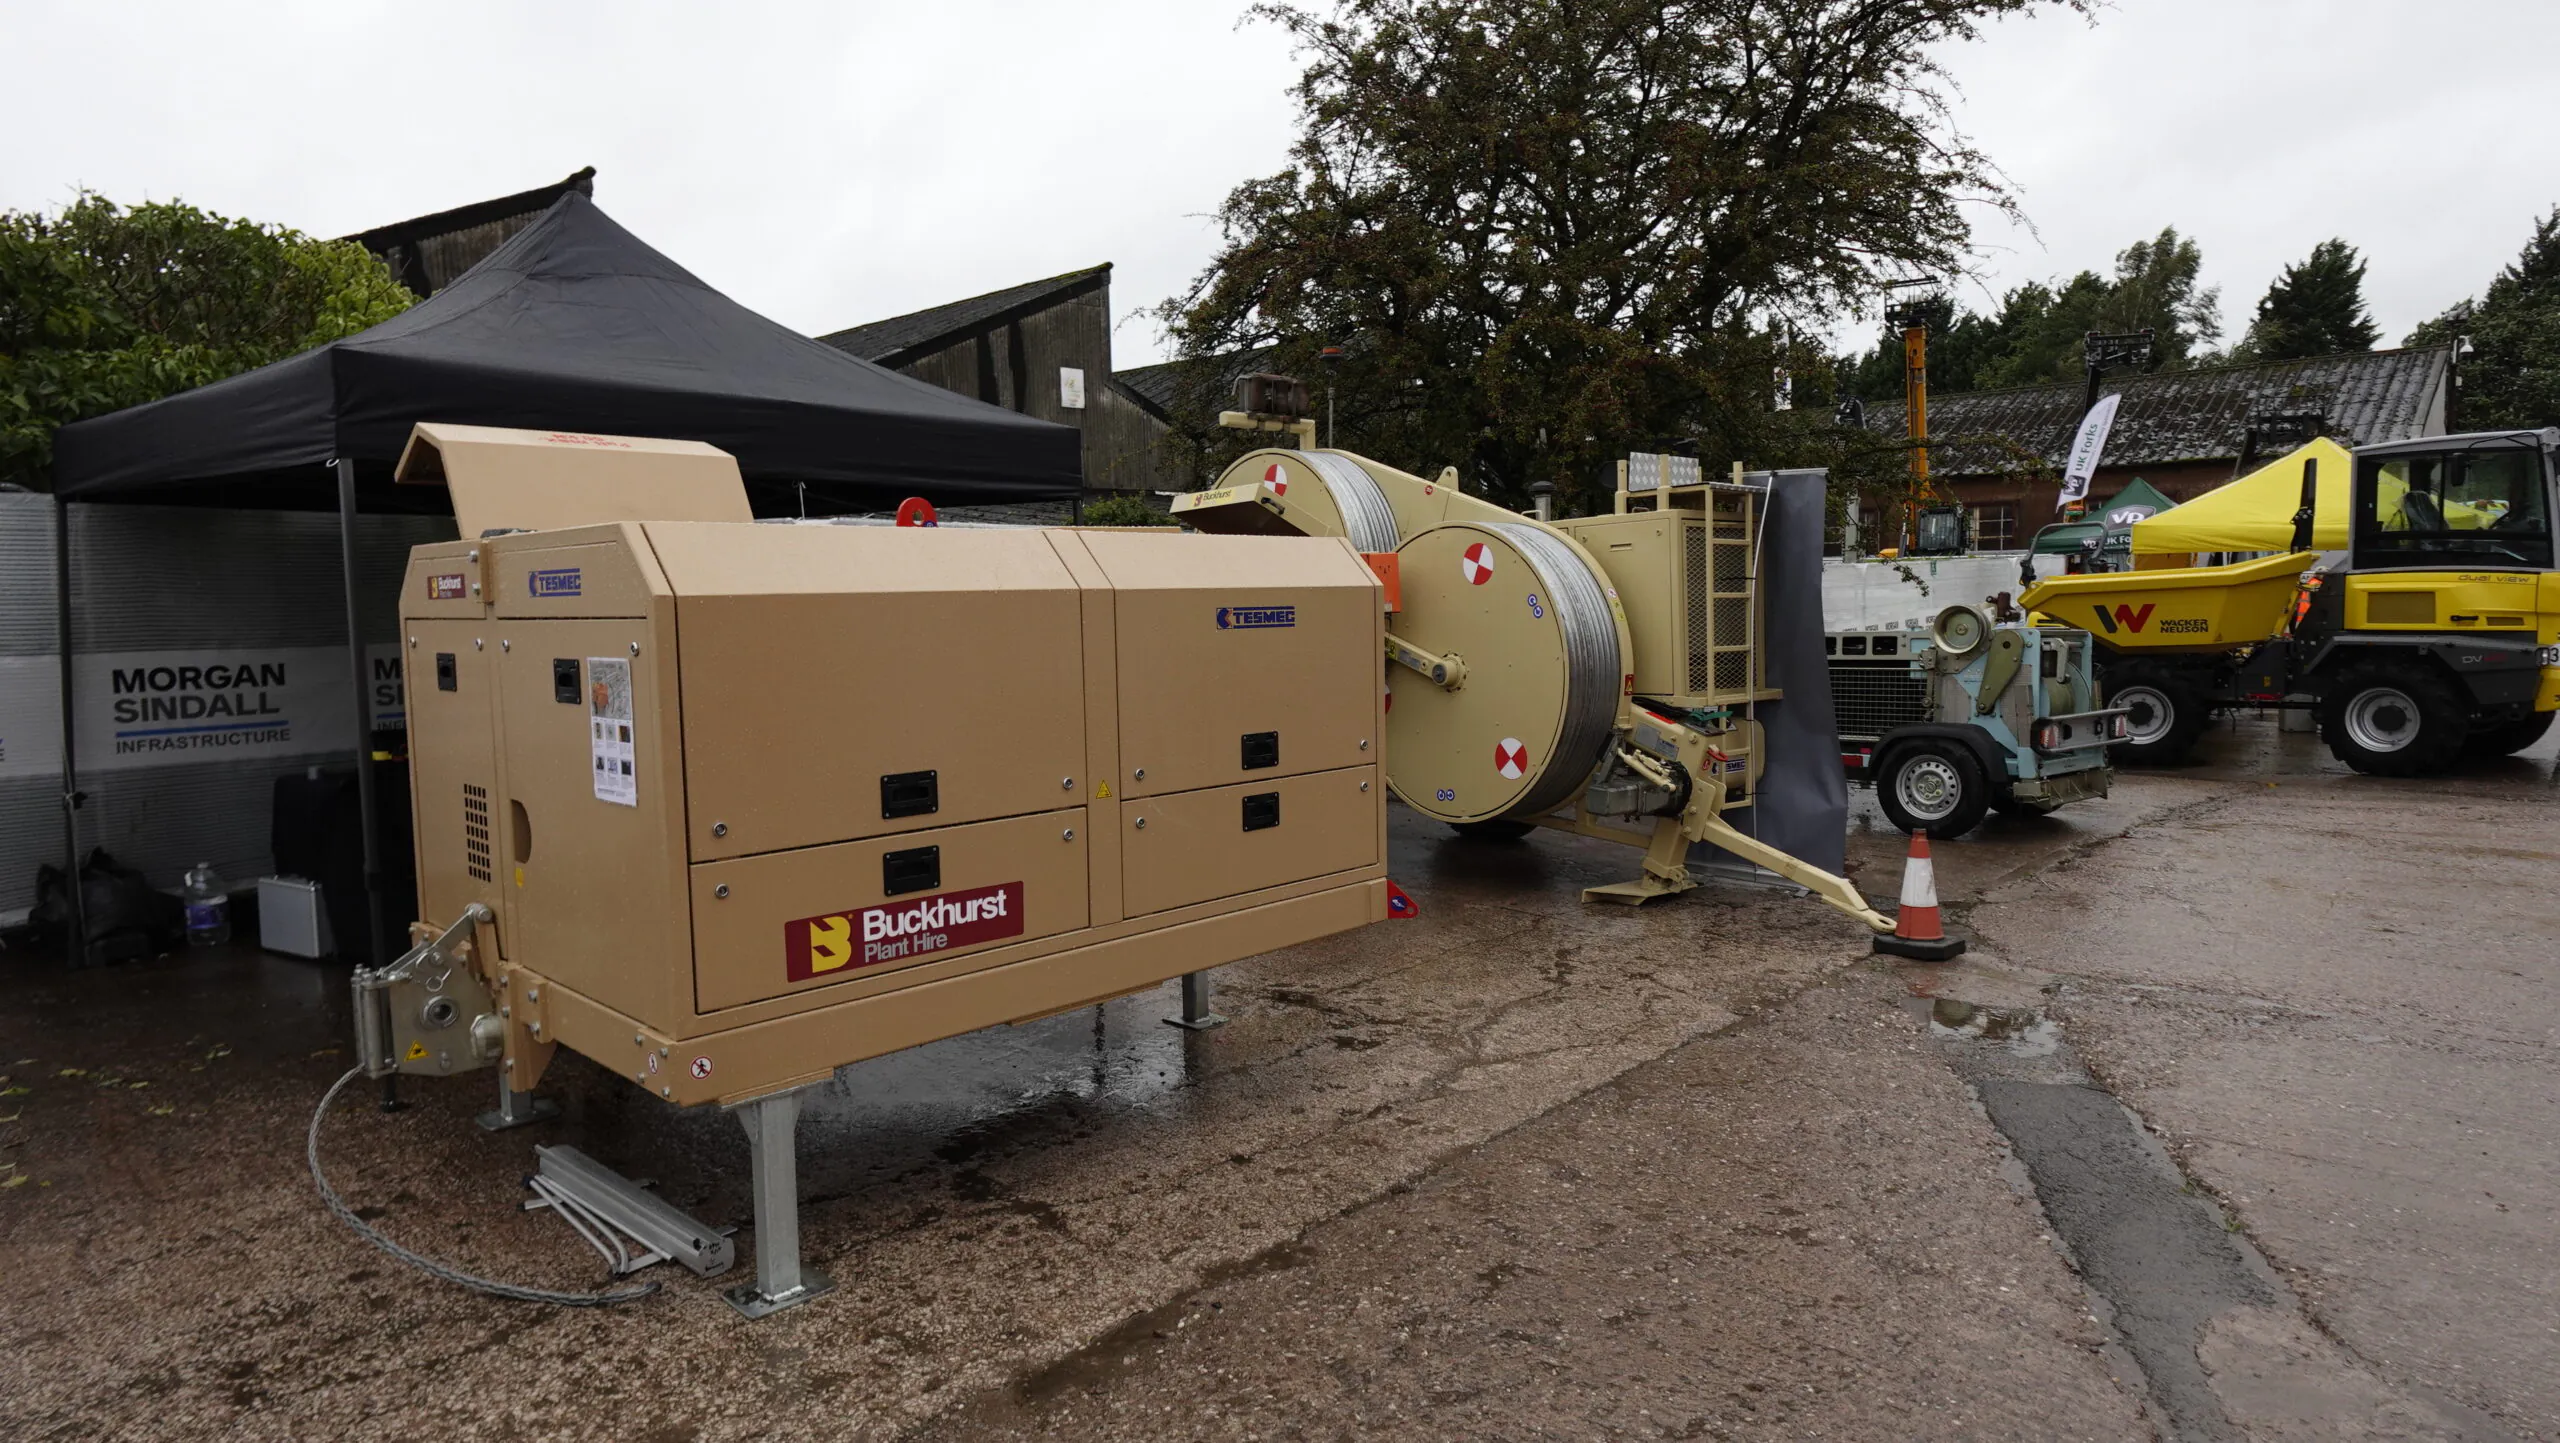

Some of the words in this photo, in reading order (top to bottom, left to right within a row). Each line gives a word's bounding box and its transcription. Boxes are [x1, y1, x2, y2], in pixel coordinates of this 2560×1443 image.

[2080, 423, 2098, 455] Forks
[2075, 456, 2088, 471] UK
[539, 574, 581, 592] TESMEC
[1233, 610, 1295, 625] TESMEC
[112, 662, 286, 694] MORGAN
[114, 691, 280, 724] SINDALL
[116, 728, 292, 755] INFRASTRUCTURE
[863, 889, 1008, 942] Buckhurst
[864, 939, 910, 963] Plant
[913, 932, 948, 954] Hire
